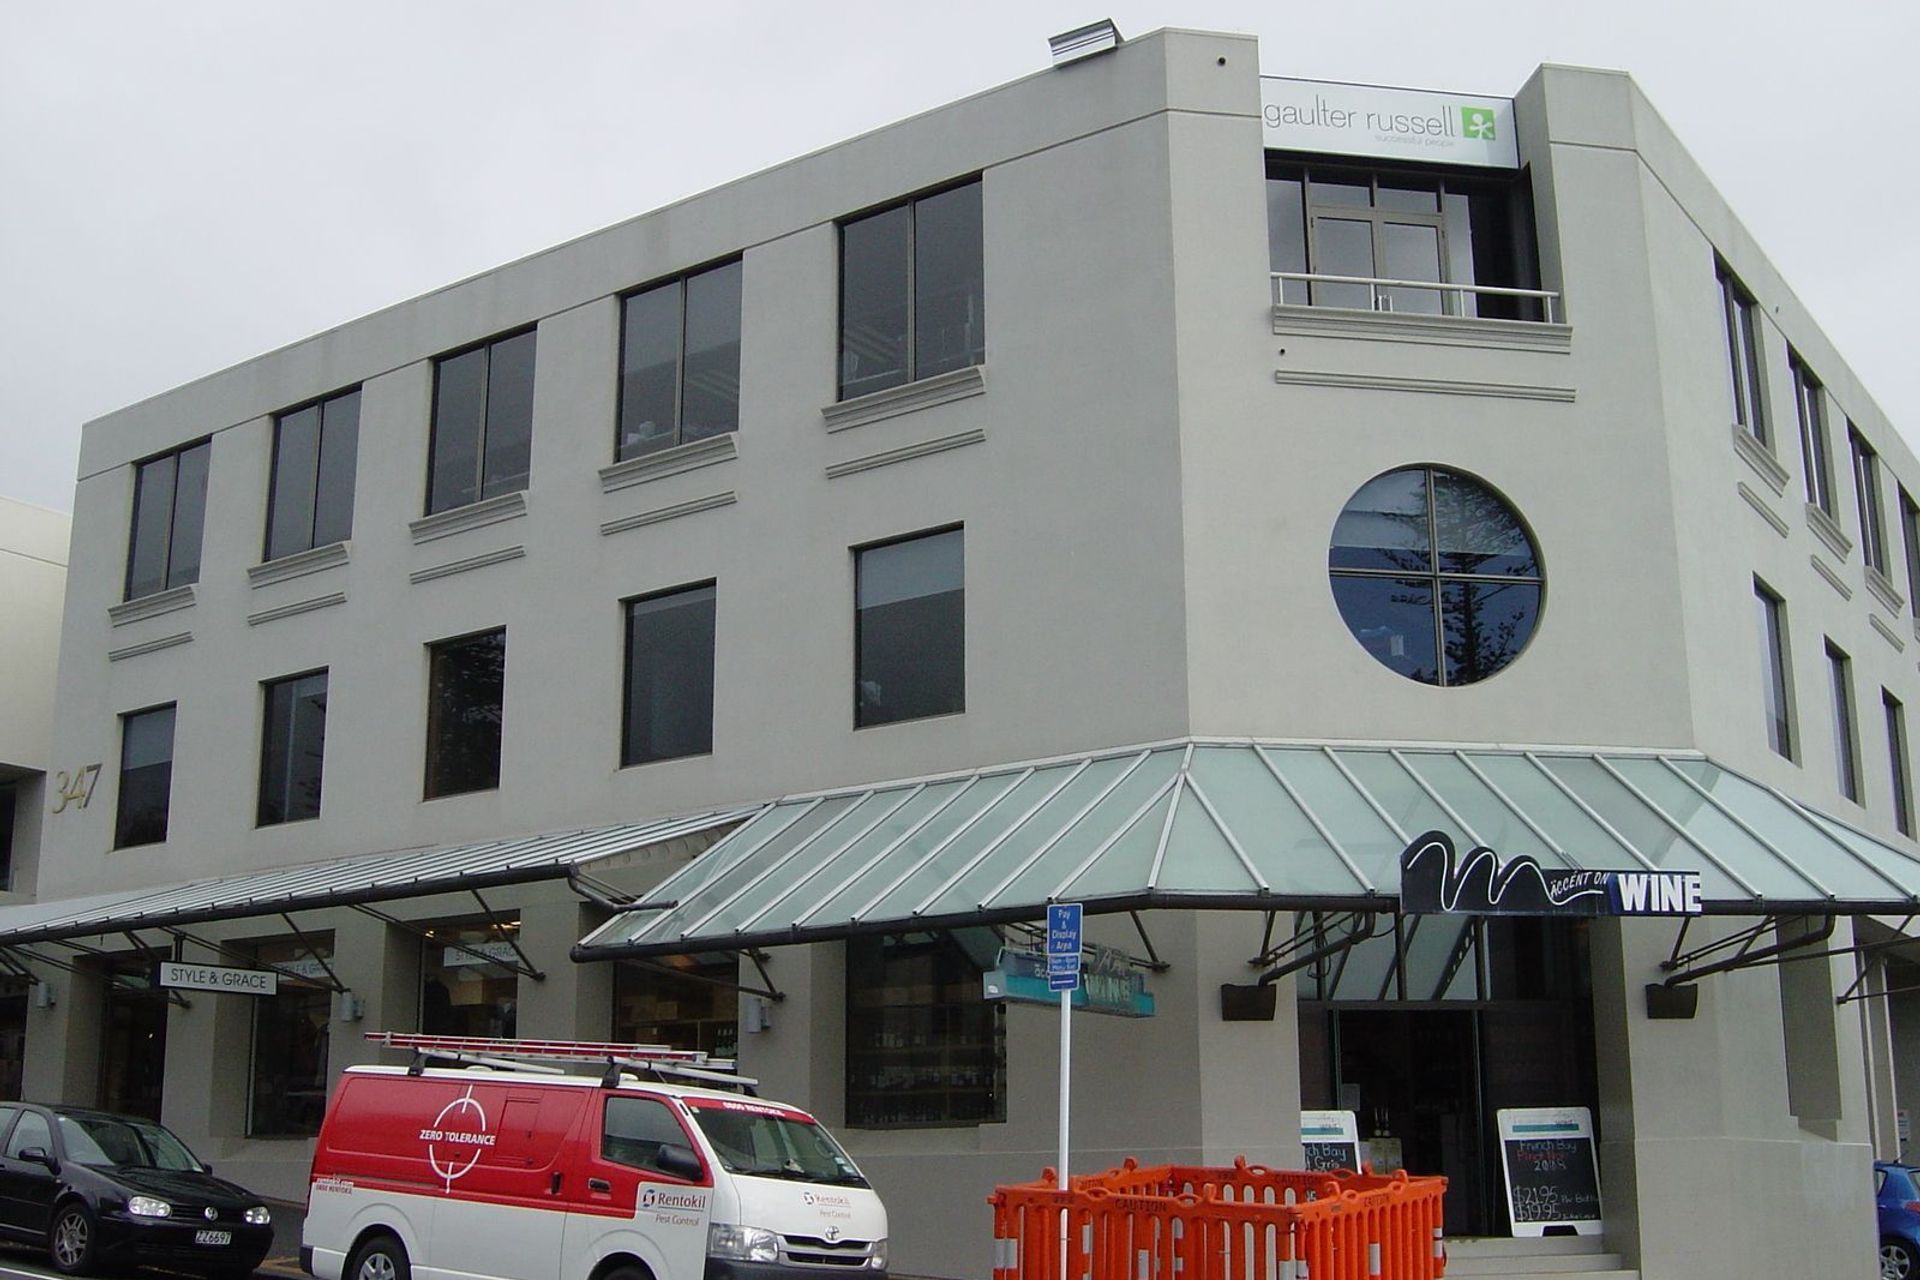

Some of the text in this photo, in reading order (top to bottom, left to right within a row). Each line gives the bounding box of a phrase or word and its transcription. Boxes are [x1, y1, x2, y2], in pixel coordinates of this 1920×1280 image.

[1264, 94, 1455, 137] gaulter russell
[52, 763, 103, 814] 347
[1593, 871, 1610, 885] ON
[1617, 873, 1702, 912] WINE
[1058, 908, 1071, 920] Pay
[1051, 929, 1077, 940] Display
[1056, 941, 1072, 951] Area
[171, 967, 267, 989] STYLE & GRACE
[419, 1129, 497, 1146] ZERO TOLERANCE
[1322, 1143, 1347, 1161] Bay
[1314, 1156, 1340, 1169] Gris
[657, 1192, 706, 1209] Rentokil
[1115, 1199, 1168, 1212] CAUTION
[656, 1213, 700, 1227] Pest Control
